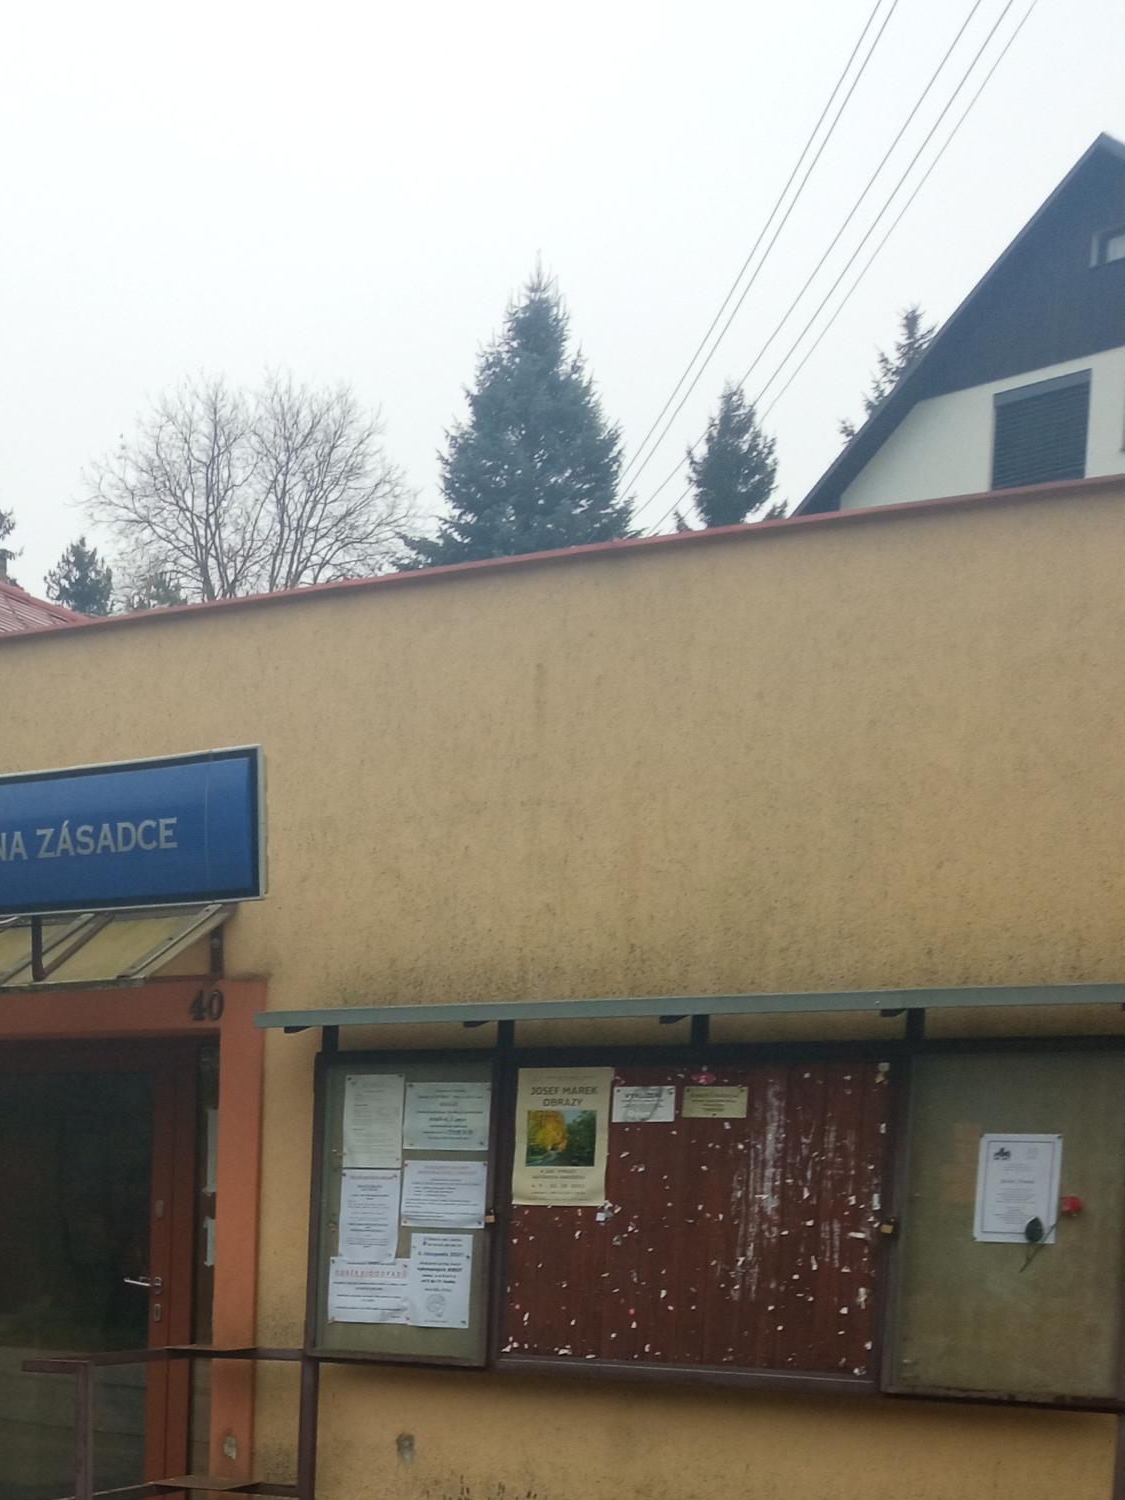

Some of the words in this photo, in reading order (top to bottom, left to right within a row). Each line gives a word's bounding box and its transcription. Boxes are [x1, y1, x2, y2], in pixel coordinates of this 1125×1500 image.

[35, 818, 178, 859] ZÁSADCE
[186, 989, 225, 1021] 40
[530, 1086, 561, 1096] JOSEF
[561, 1085, 598, 1096] MAREK
[542, 1098, 584, 1107] OBRAZY
